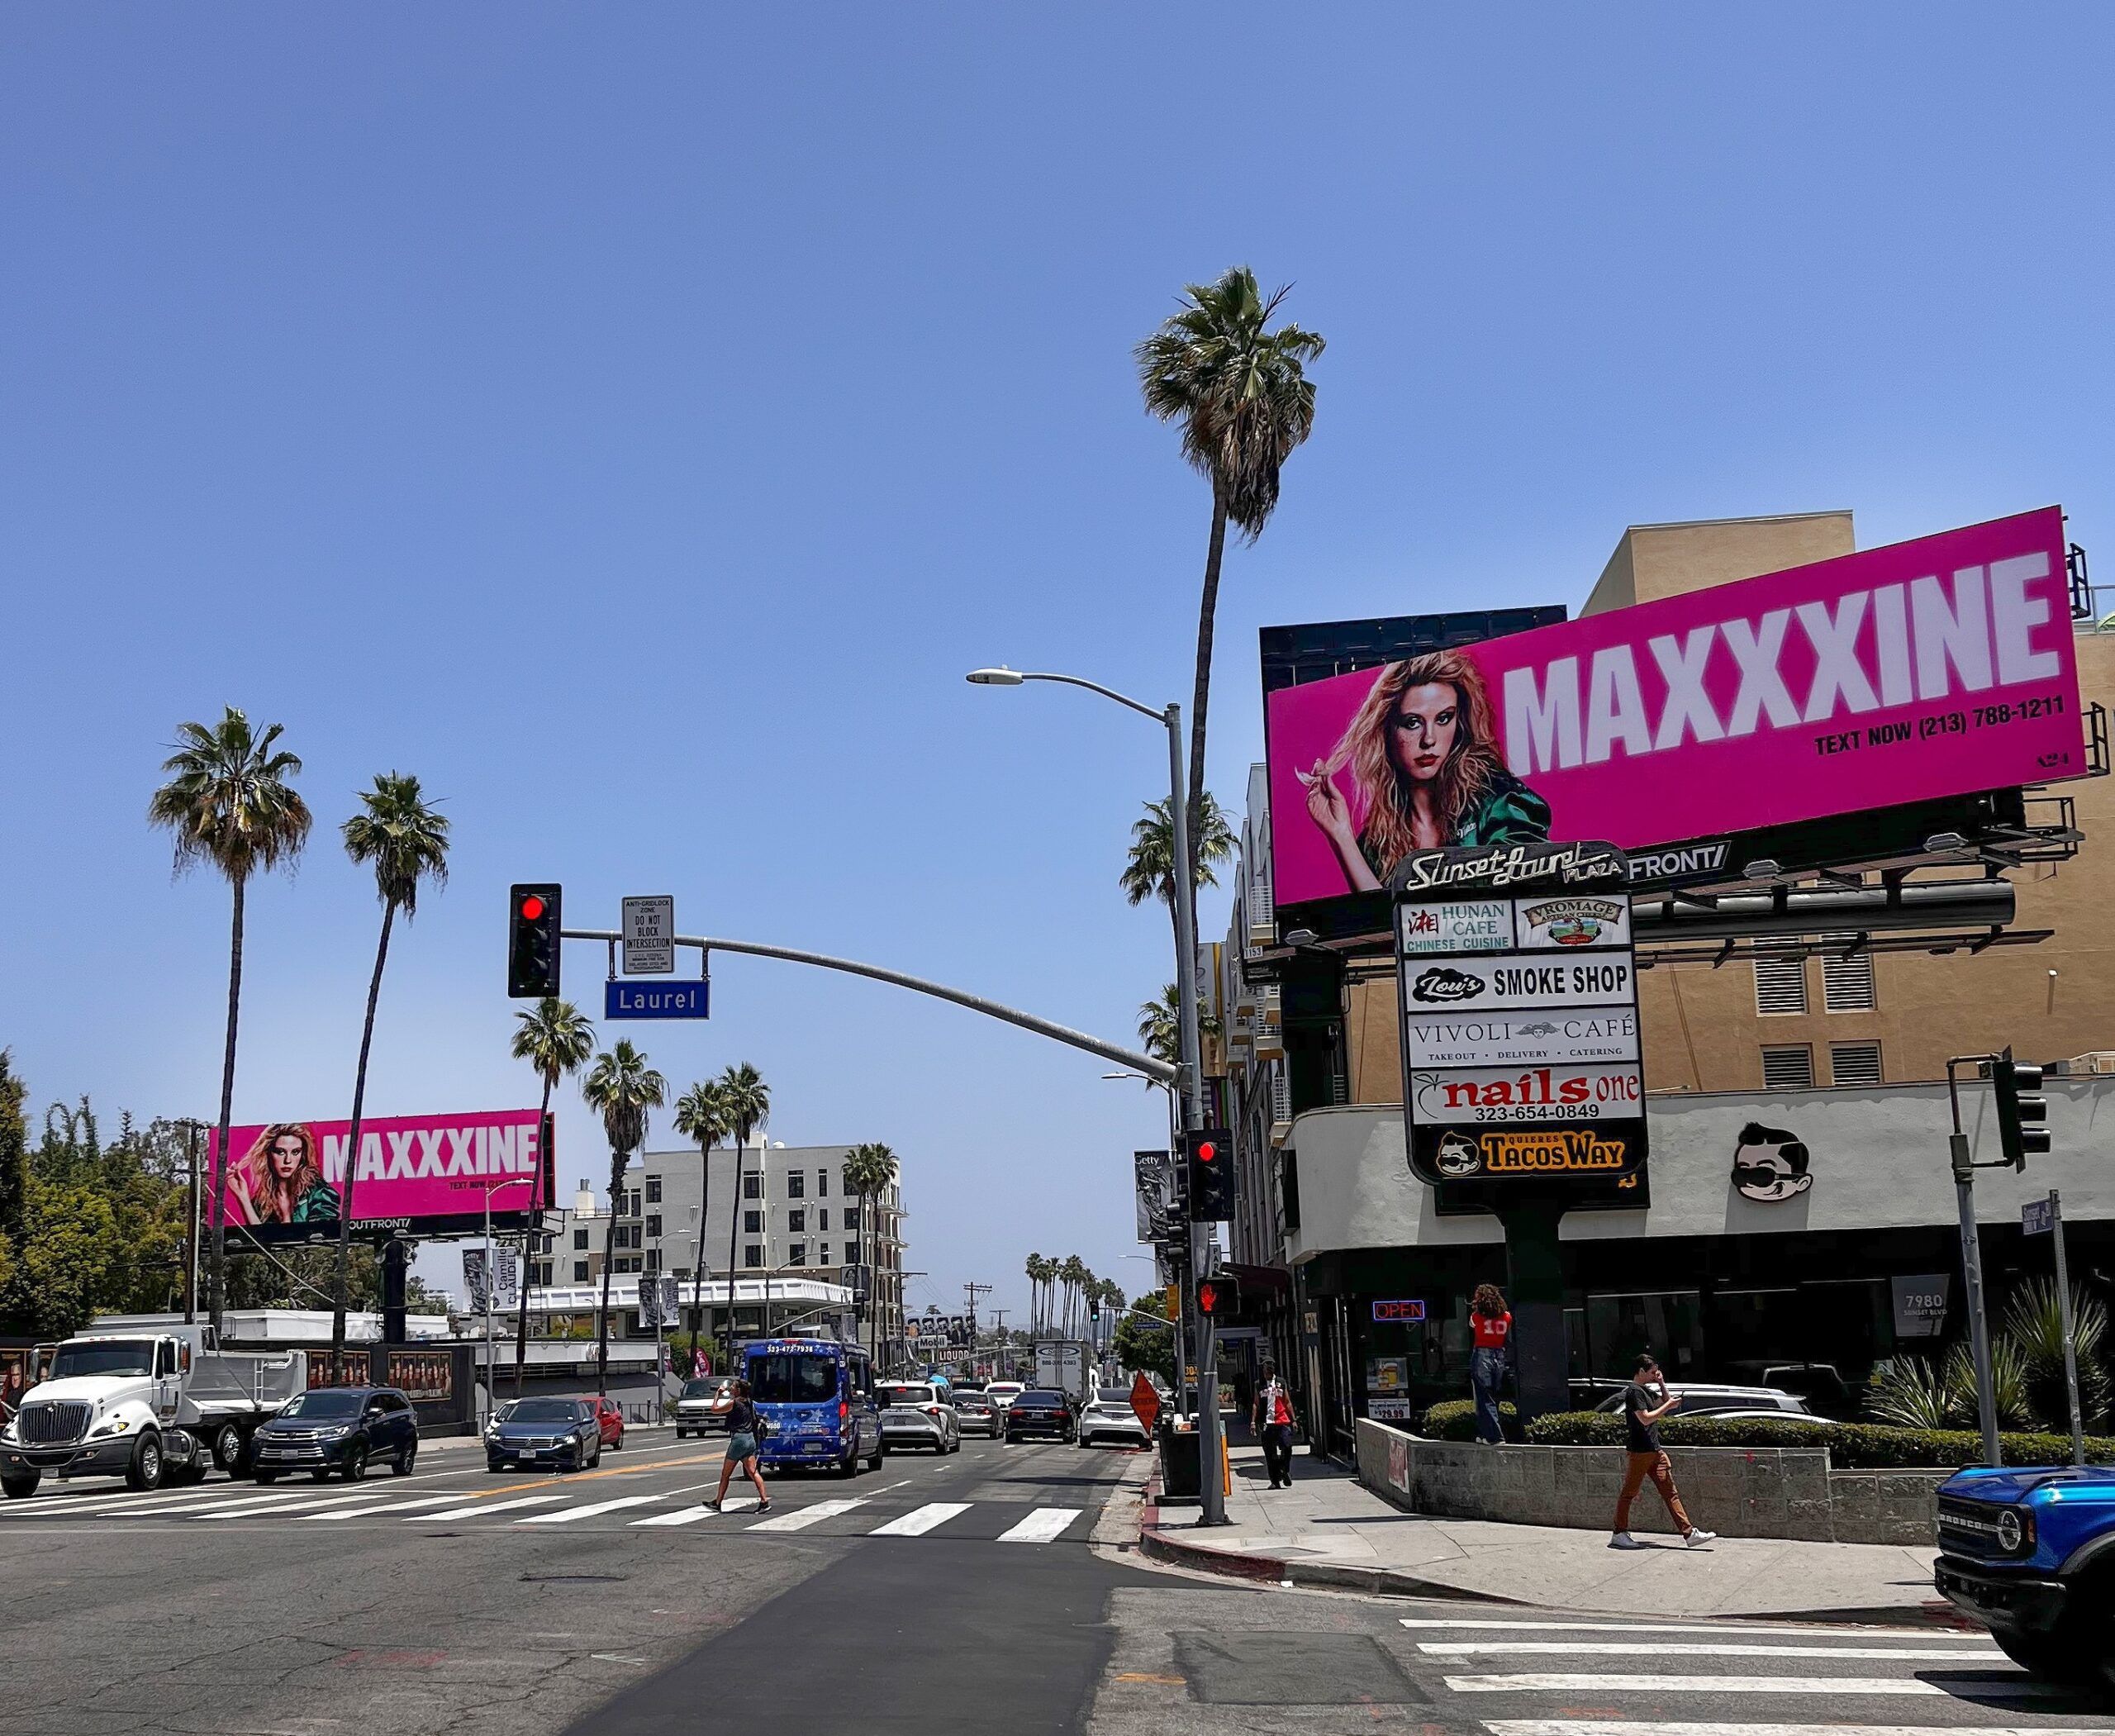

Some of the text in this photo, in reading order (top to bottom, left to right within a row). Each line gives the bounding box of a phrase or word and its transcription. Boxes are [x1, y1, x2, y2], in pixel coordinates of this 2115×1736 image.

[1503, 550, 2060, 778] MAXXXINE
[1814, 696, 2065, 755] TEXT NOW (213) 788-1211
[1407, 842, 1611, 891] Sunset Laurel
[1563, 859, 1623, 883] PLAZA
[1442, 904, 1505, 919] HUNAN
[1534, 901, 1616, 917] VROMAGE
[635, 915, 661, 925] DO NOT
[1452, 920, 1498, 935] CAFE
[638, 927, 658, 936] BLOCK
[626, 939, 670, 949] INTERSECTION
[1407, 936, 1509, 952] CHINESE CUISINE
[1420, 965, 1628, 997] Lou's SMOKE SHOP
[620, 990, 695, 1009] Laurel
[1414, 1014, 1636, 1043] VIVOLI CAFÉ
[1498, 1050, 1548, 1058] DELIVERY
[1570, 1048, 1623, 1056] CATERING
[1442, 1068, 1639, 1108] nails one
[1476, 1104, 1599, 1121] 323-654-0849
[1509, 1135, 1559, 1144] QUIERES
[323, 1125, 538, 1182] MAXXXINE
[1134, 1155, 1158, 1165] Getty
[499, 1248, 508, 1291] Camille
[508, 1250, 517, 1305] CLAUDEL
[1906, 1295, 1942, 1307] 7980
[1376, 1303, 1422, 1319] OPEN
[1484, 1320, 1508, 1334] 10
[939, 1351, 969, 1361] LIQUOR
